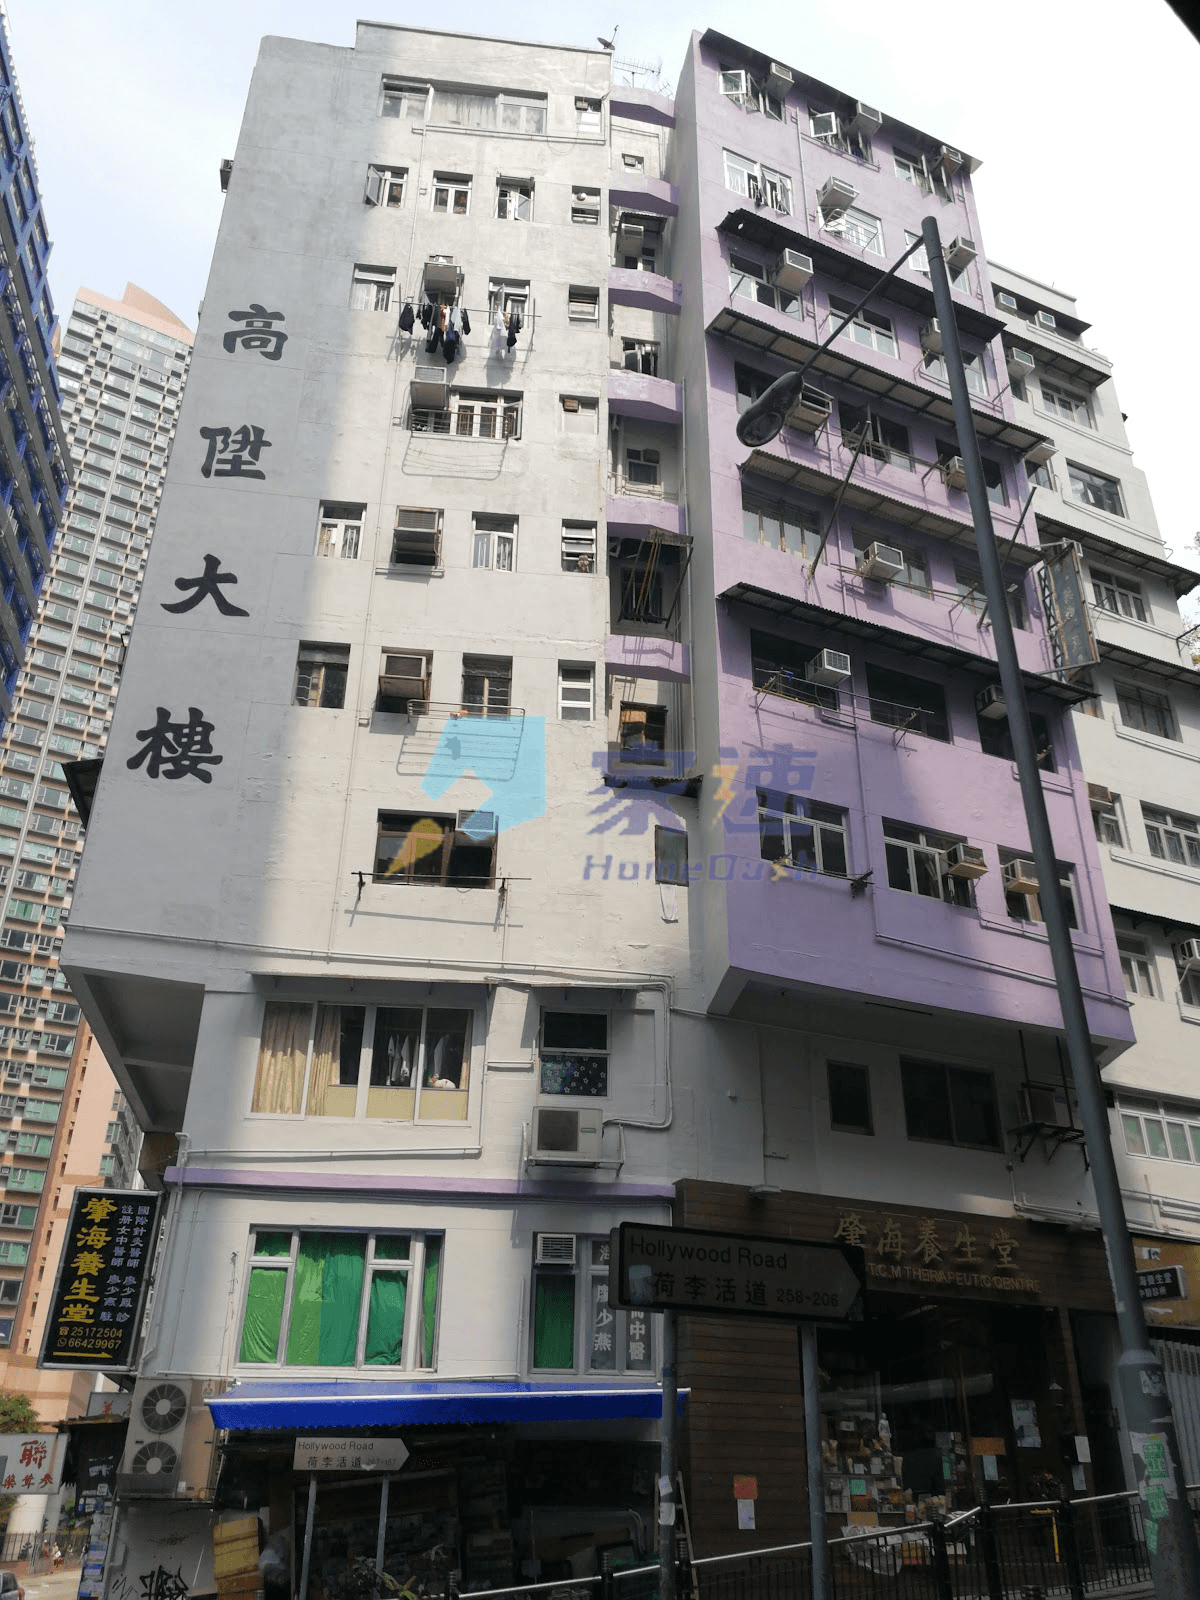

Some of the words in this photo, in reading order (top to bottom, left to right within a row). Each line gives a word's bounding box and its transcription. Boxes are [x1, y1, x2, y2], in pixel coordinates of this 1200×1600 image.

[126, 303, 288, 784] 高陞大樓
[630, 1235, 731, 1263] Hollywood
[737, 1247, 788, 1269] Road
[834, 1213, 1020, 1269] 肇海養生堂
[57, 1196, 119, 1324] 肇海養生堂
[652, 1271, 768, 1306] 荷李活道
[992, 1276, 1042, 1293] CENTRE
[67, 1337, 122, 1349] 66429967
[70, 1326, 123, 1339] 25172504
[297, 1441, 347, 1452] Hollywood
[349, 1441, 374, 1451] Road
[307, 1456, 362, 1469] 荷李活道
